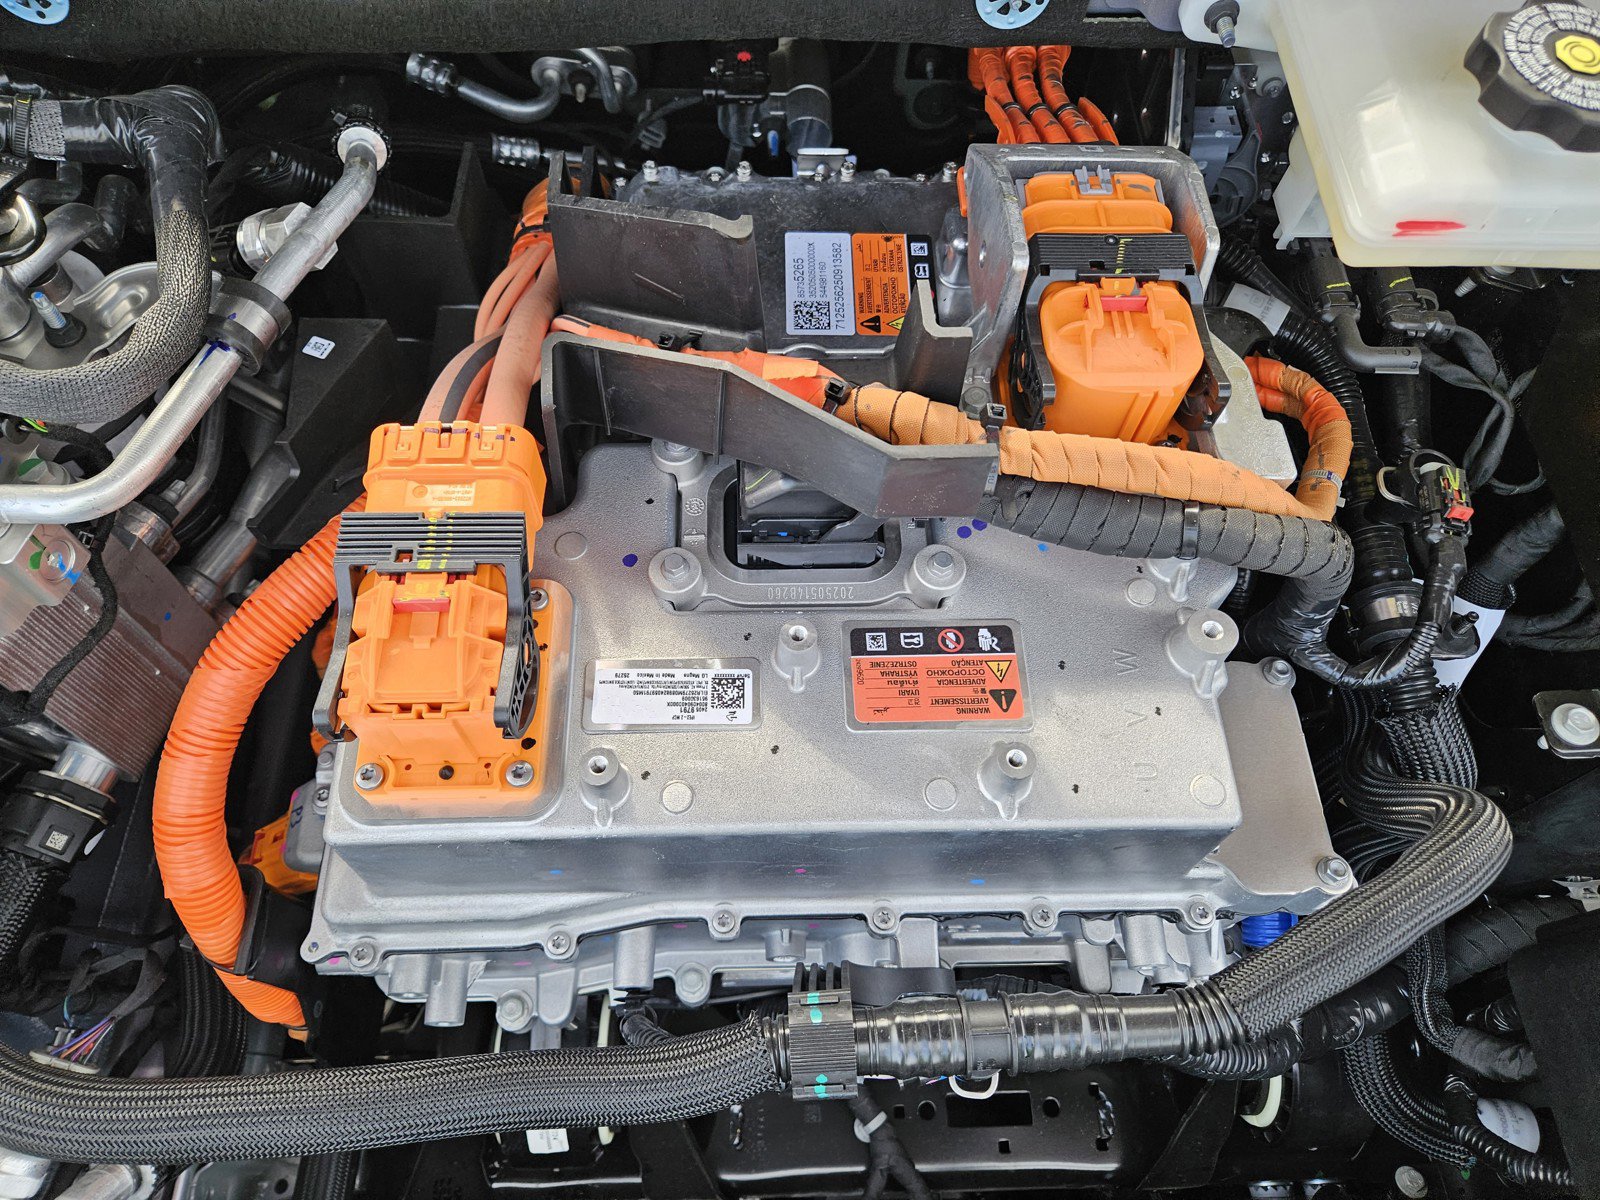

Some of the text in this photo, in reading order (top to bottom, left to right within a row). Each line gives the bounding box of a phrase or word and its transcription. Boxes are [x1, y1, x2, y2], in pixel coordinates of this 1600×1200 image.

[793, 258, 805, 298] 85735265
[832, 243, 845, 330] 7125256250913582
[865, 277, 873, 314] AVERTISSEMENT
[951, 658, 983, 668] ATENÇÃO
[879, 670, 918, 679] VÝSTRAHA
[926, 668, 985, 677] ОСТОРОЖНО
[936, 678, 986, 686] ADVERTENCIA
[930, 697, 989, 706] AVERTISSEMENT
[956, 707, 990, 715] WARNING
